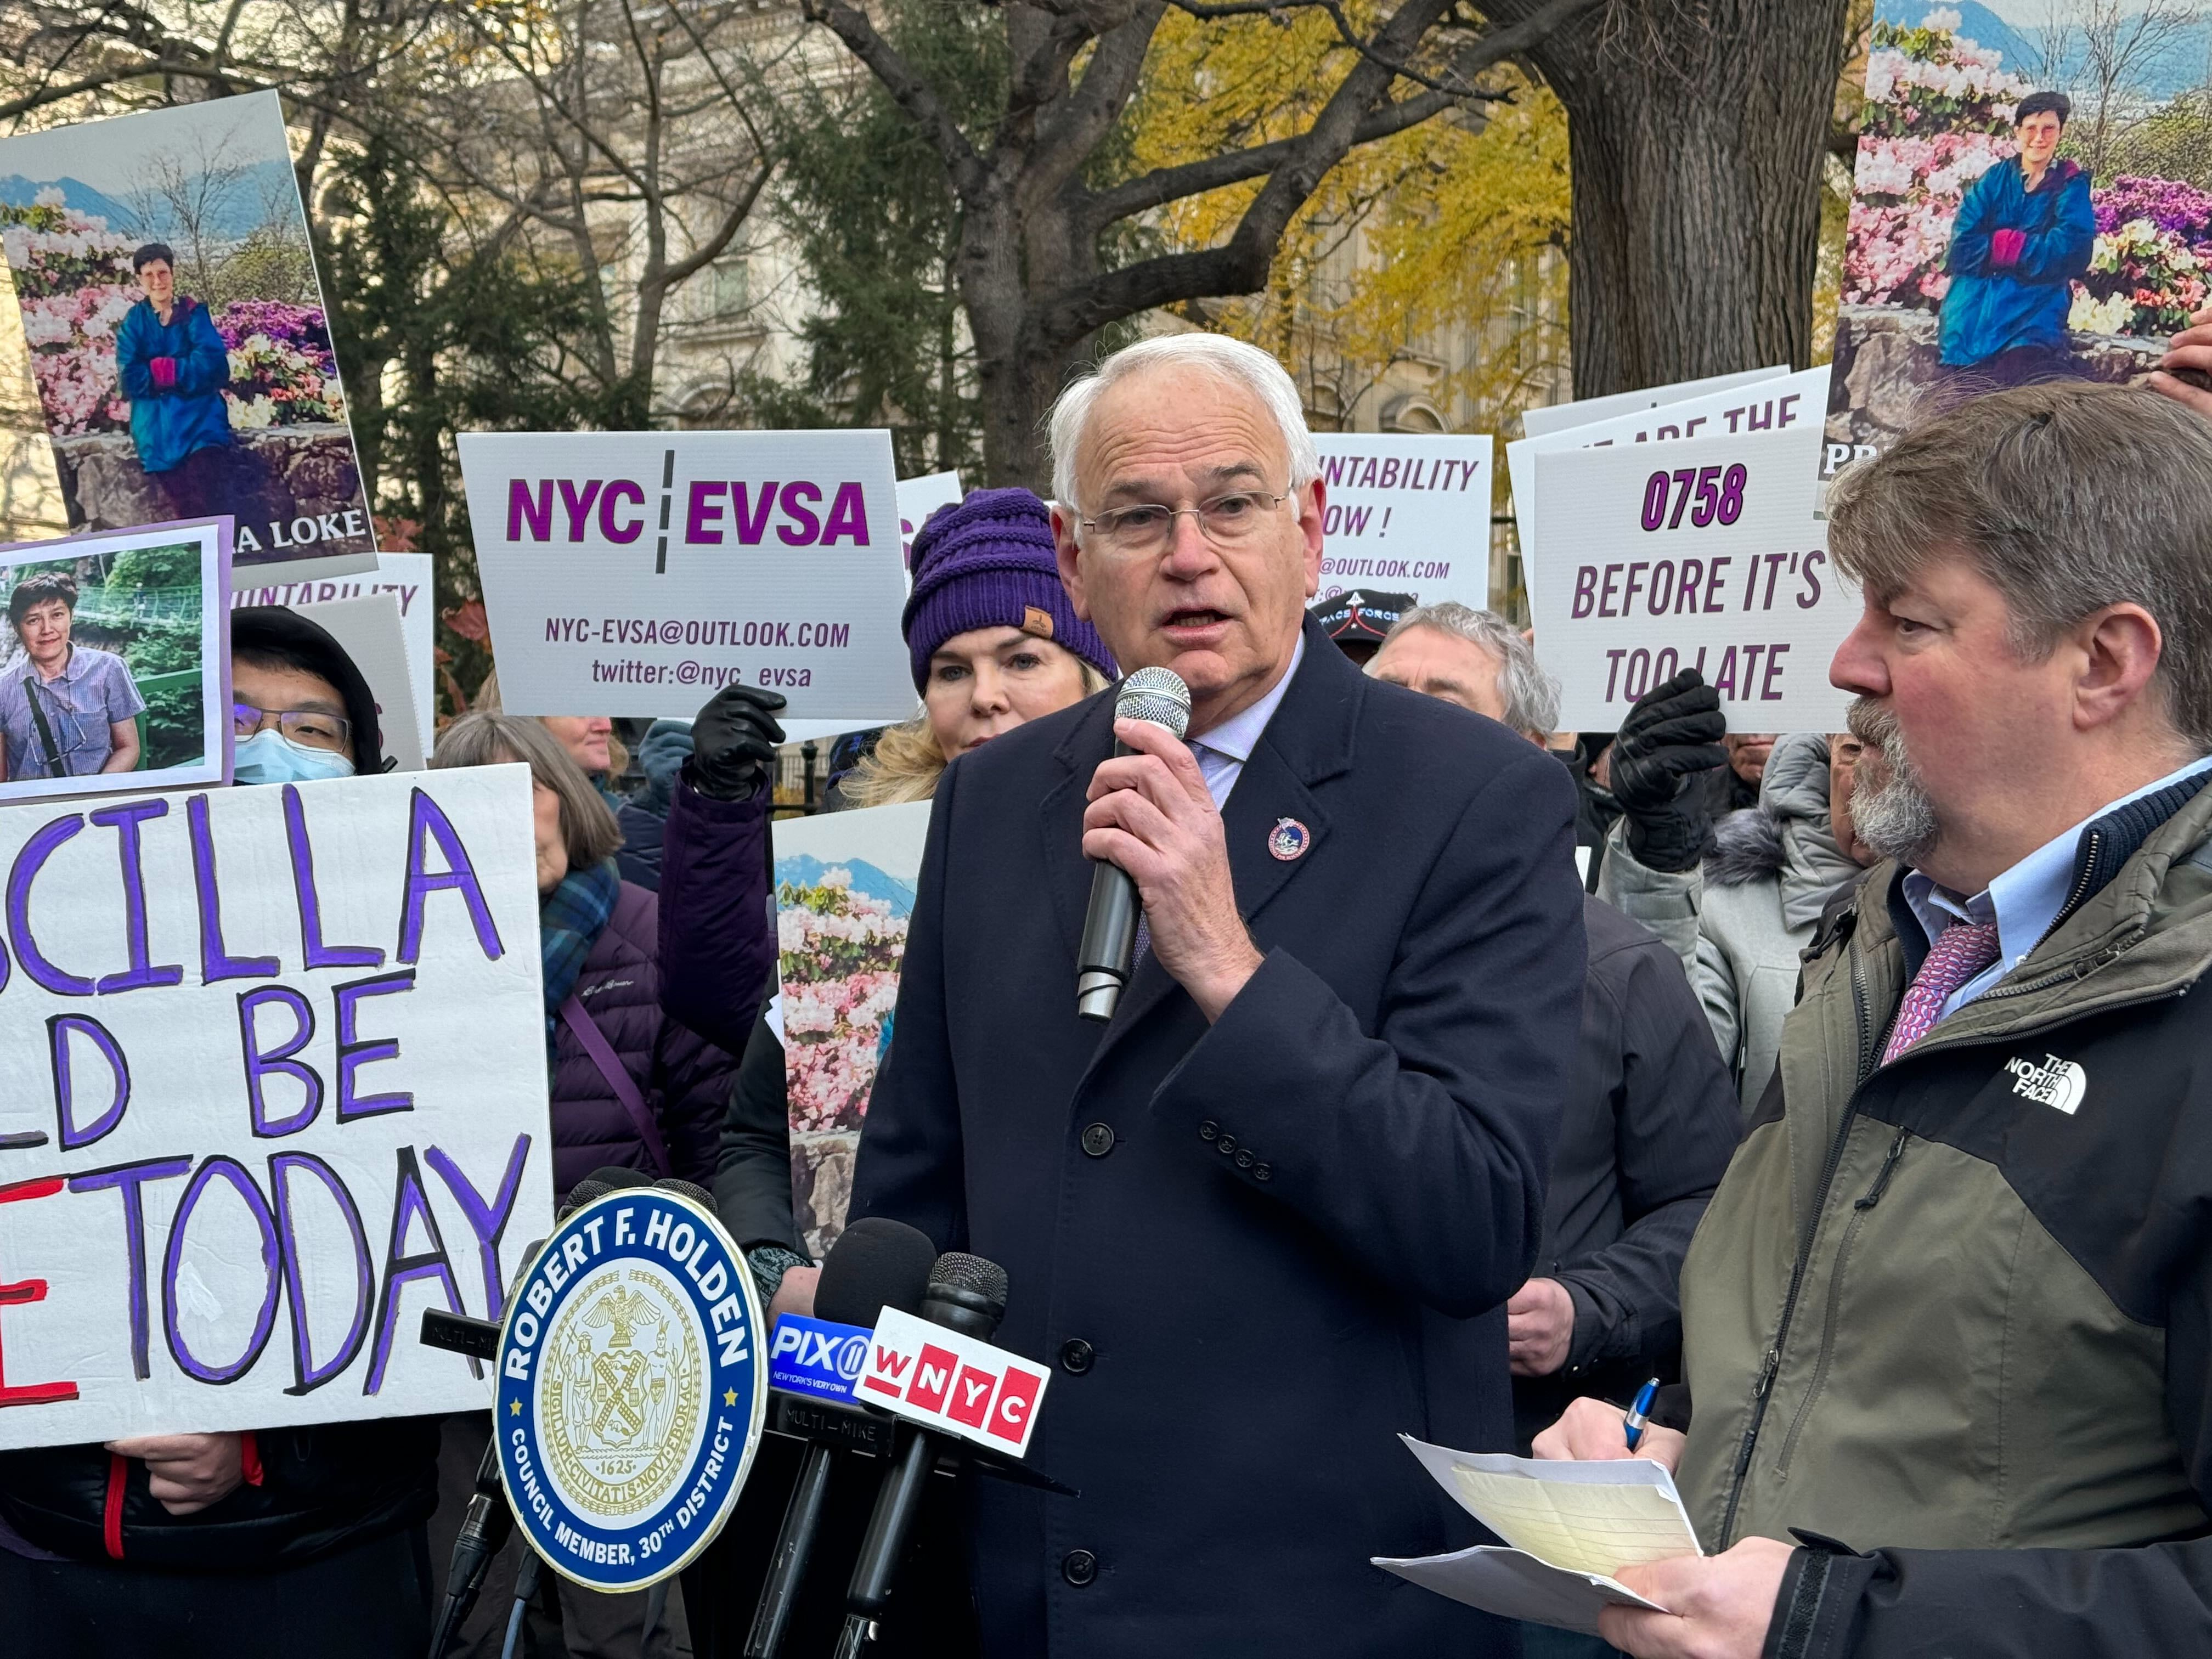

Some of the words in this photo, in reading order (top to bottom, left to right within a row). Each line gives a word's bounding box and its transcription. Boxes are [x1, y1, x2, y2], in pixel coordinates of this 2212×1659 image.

[1318, 455, 1479, 492] NTABILITY
[1641, 463, 1747, 532] 0758
[269, 509, 366, 548] LOKE
[506, 479, 645, 544] NYC
[685, 481, 870, 546] EVSA
[232, 583, 419, 618] NTABIY
[1571, 556, 1732, 620] BEFORE
[1742, 550, 1826, 612] IT'S
[545, 618, 850, 648] NYC-EVSA@OUTLOOK.COM
[1357, 607, 1400, 622] FORCE
[1605, 647, 1679, 703] TOO
[0, 783, 505, 996] CILLA
[236, 969, 416, 1139] BE
[2004, 1056, 2063, 1089] NORTH
[2043, 1053, 2073, 1075] THE
[2012, 1077, 2053, 1102] FACE
[67, 1132, 532, 1396] TODAY
[505, 1216, 603, 1381] ROBERT
[615, 1207, 636, 1246] F.
[644, 1209, 748, 1368] HOLDEN
[772, 1370, 789, 1381] NEW
[877, 1344, 1026, 1424] WNYC
[511, 1428, 555, 1531] COUNCIL
[554, 1520, 636, 1566] MEMBER,
[675, 1415, 733, 1530] DISTRICT
